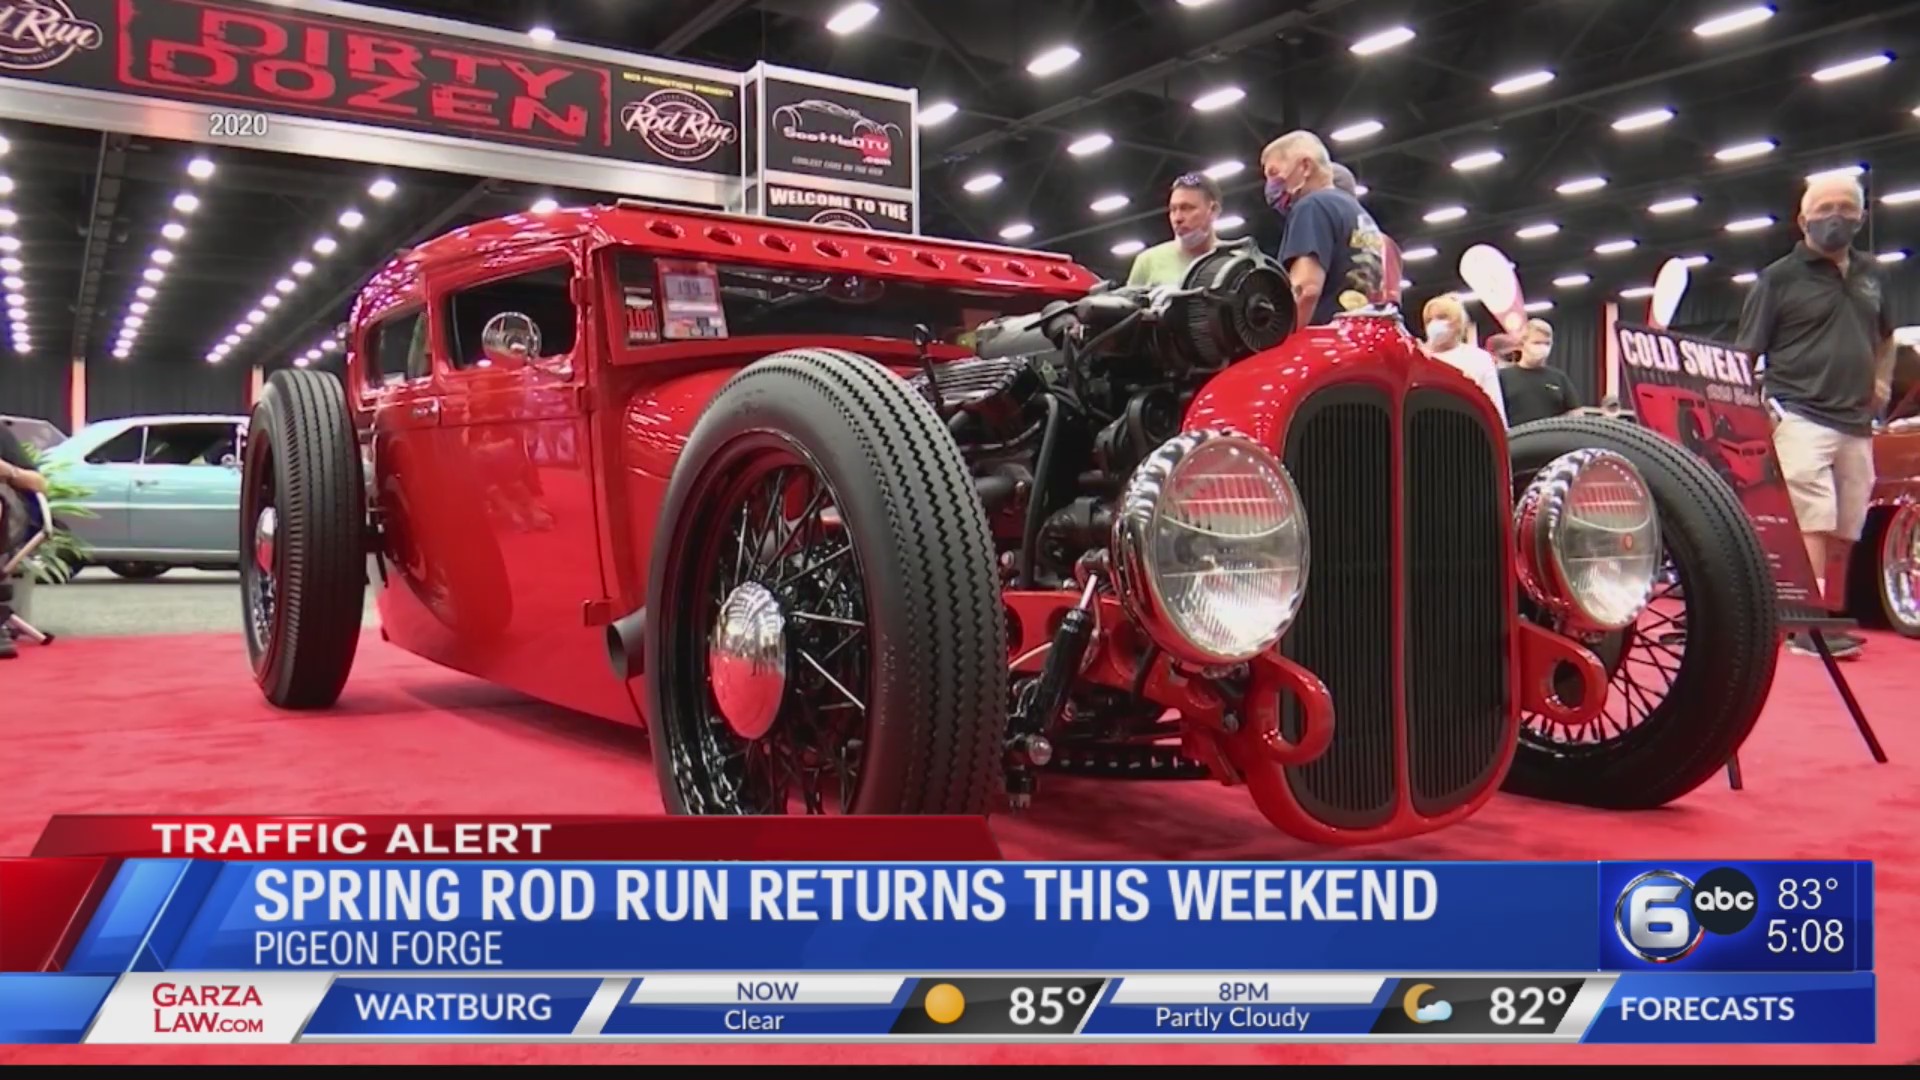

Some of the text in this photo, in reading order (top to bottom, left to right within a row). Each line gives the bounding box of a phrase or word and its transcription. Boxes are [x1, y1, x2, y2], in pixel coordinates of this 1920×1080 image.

[12, 5, 95, 47] Run
[202, 9, 573, 99] DIRTY
[150, 40, 588, 138] DOZEN
[625, 104, 733, 144] Rod Run
[769, 186, 851, 208] WELCOME
[854, 197, 876, 213] TO
[878, 200, 909, 221] THE
[1620, 329, 1753, 387] COLD SWEAT
